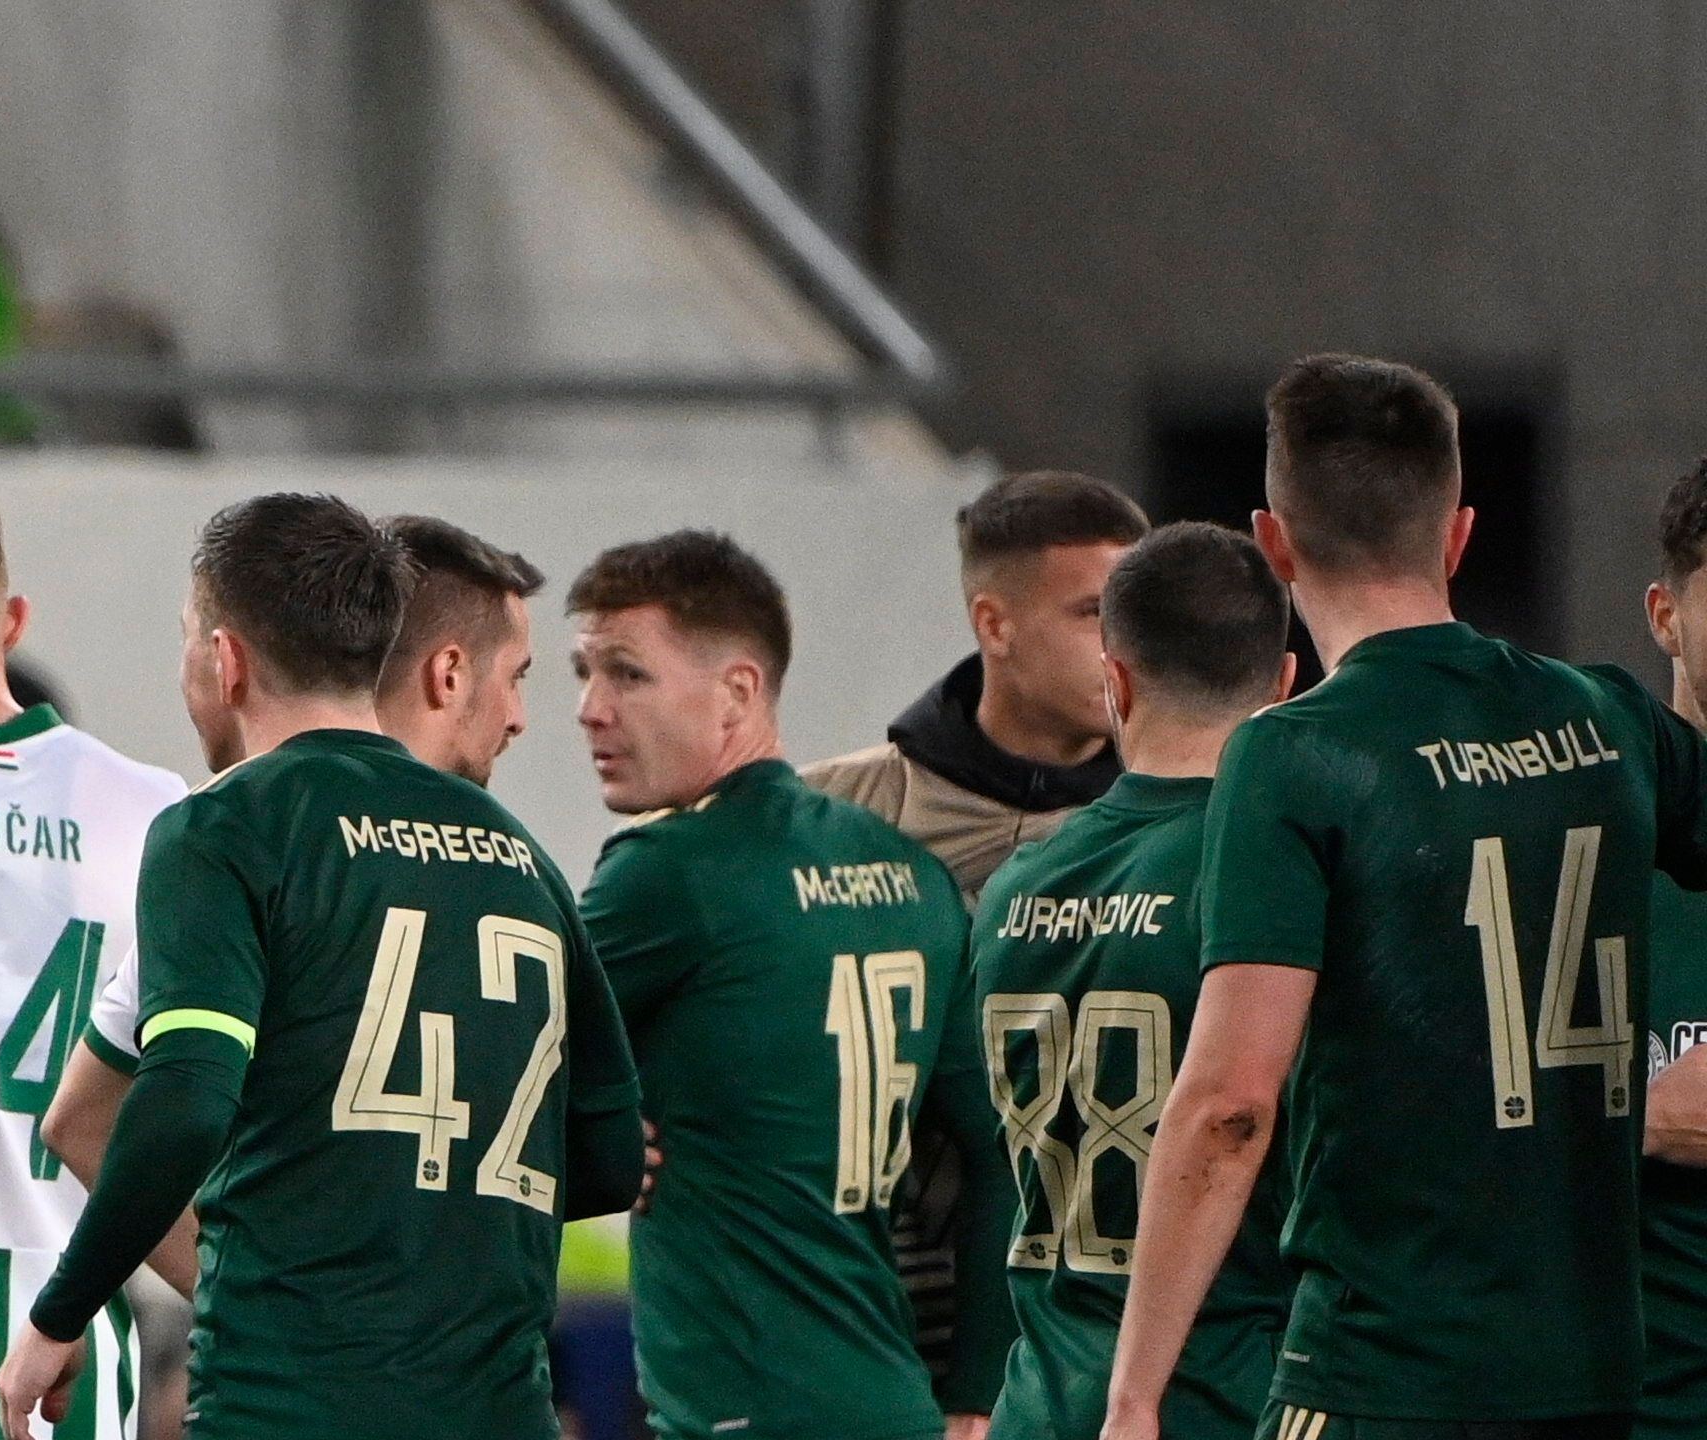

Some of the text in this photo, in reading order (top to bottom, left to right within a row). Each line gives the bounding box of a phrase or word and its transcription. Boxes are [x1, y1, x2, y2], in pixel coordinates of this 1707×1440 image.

[337, 815, 539, 878] McGREGOR
[1415, 717, 1619, 790] TURNBULL
[997, 891, 1175, 944] JURANOVIC
[1464, 826, 1634, 1129] 14
[332, 907, 567, 1216] 42
[824, 950, 926, 1215] 16
[983, 990, 1172, 1276] 88
